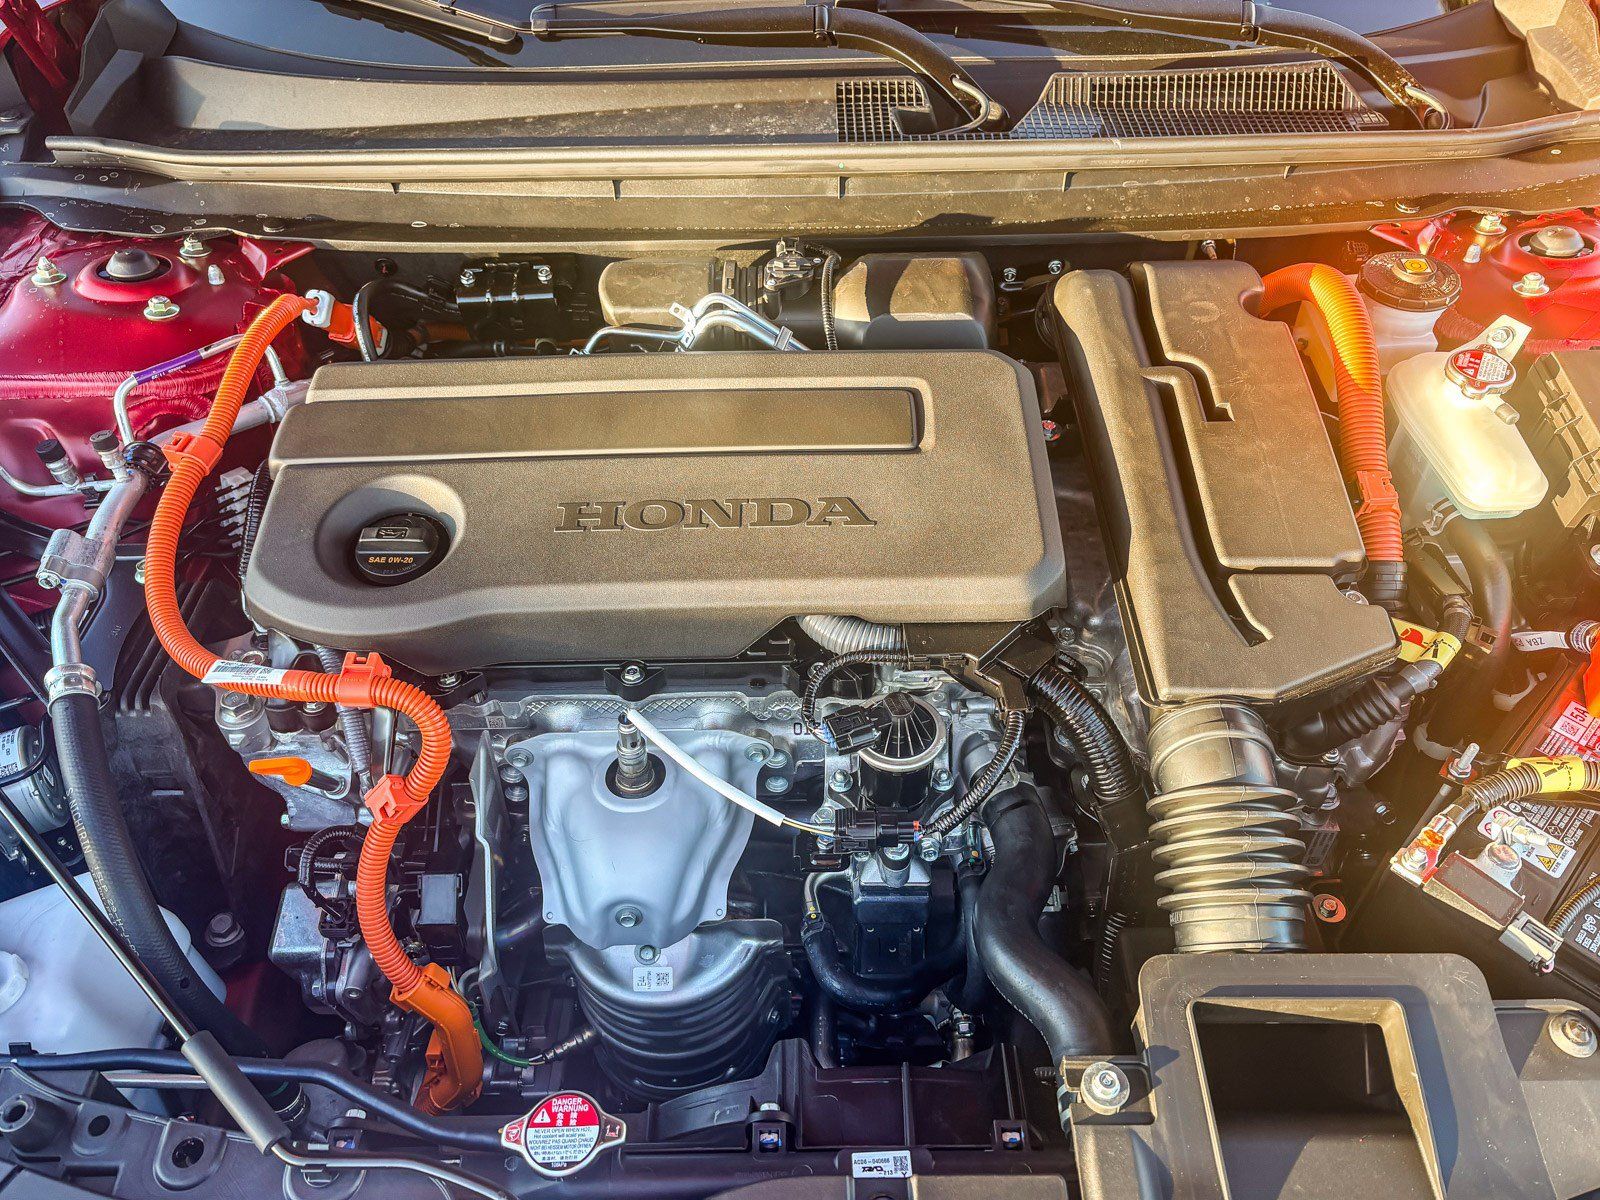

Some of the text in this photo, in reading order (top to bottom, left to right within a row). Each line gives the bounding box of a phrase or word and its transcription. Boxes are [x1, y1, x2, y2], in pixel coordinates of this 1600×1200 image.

[554, 497, 877, 532] HONDA
[68, 798, 93, 854] NICHIRIN
[551, 1104, 589, 1113] WARNUNG
[552, 1097, 582, 1105] DANGER
